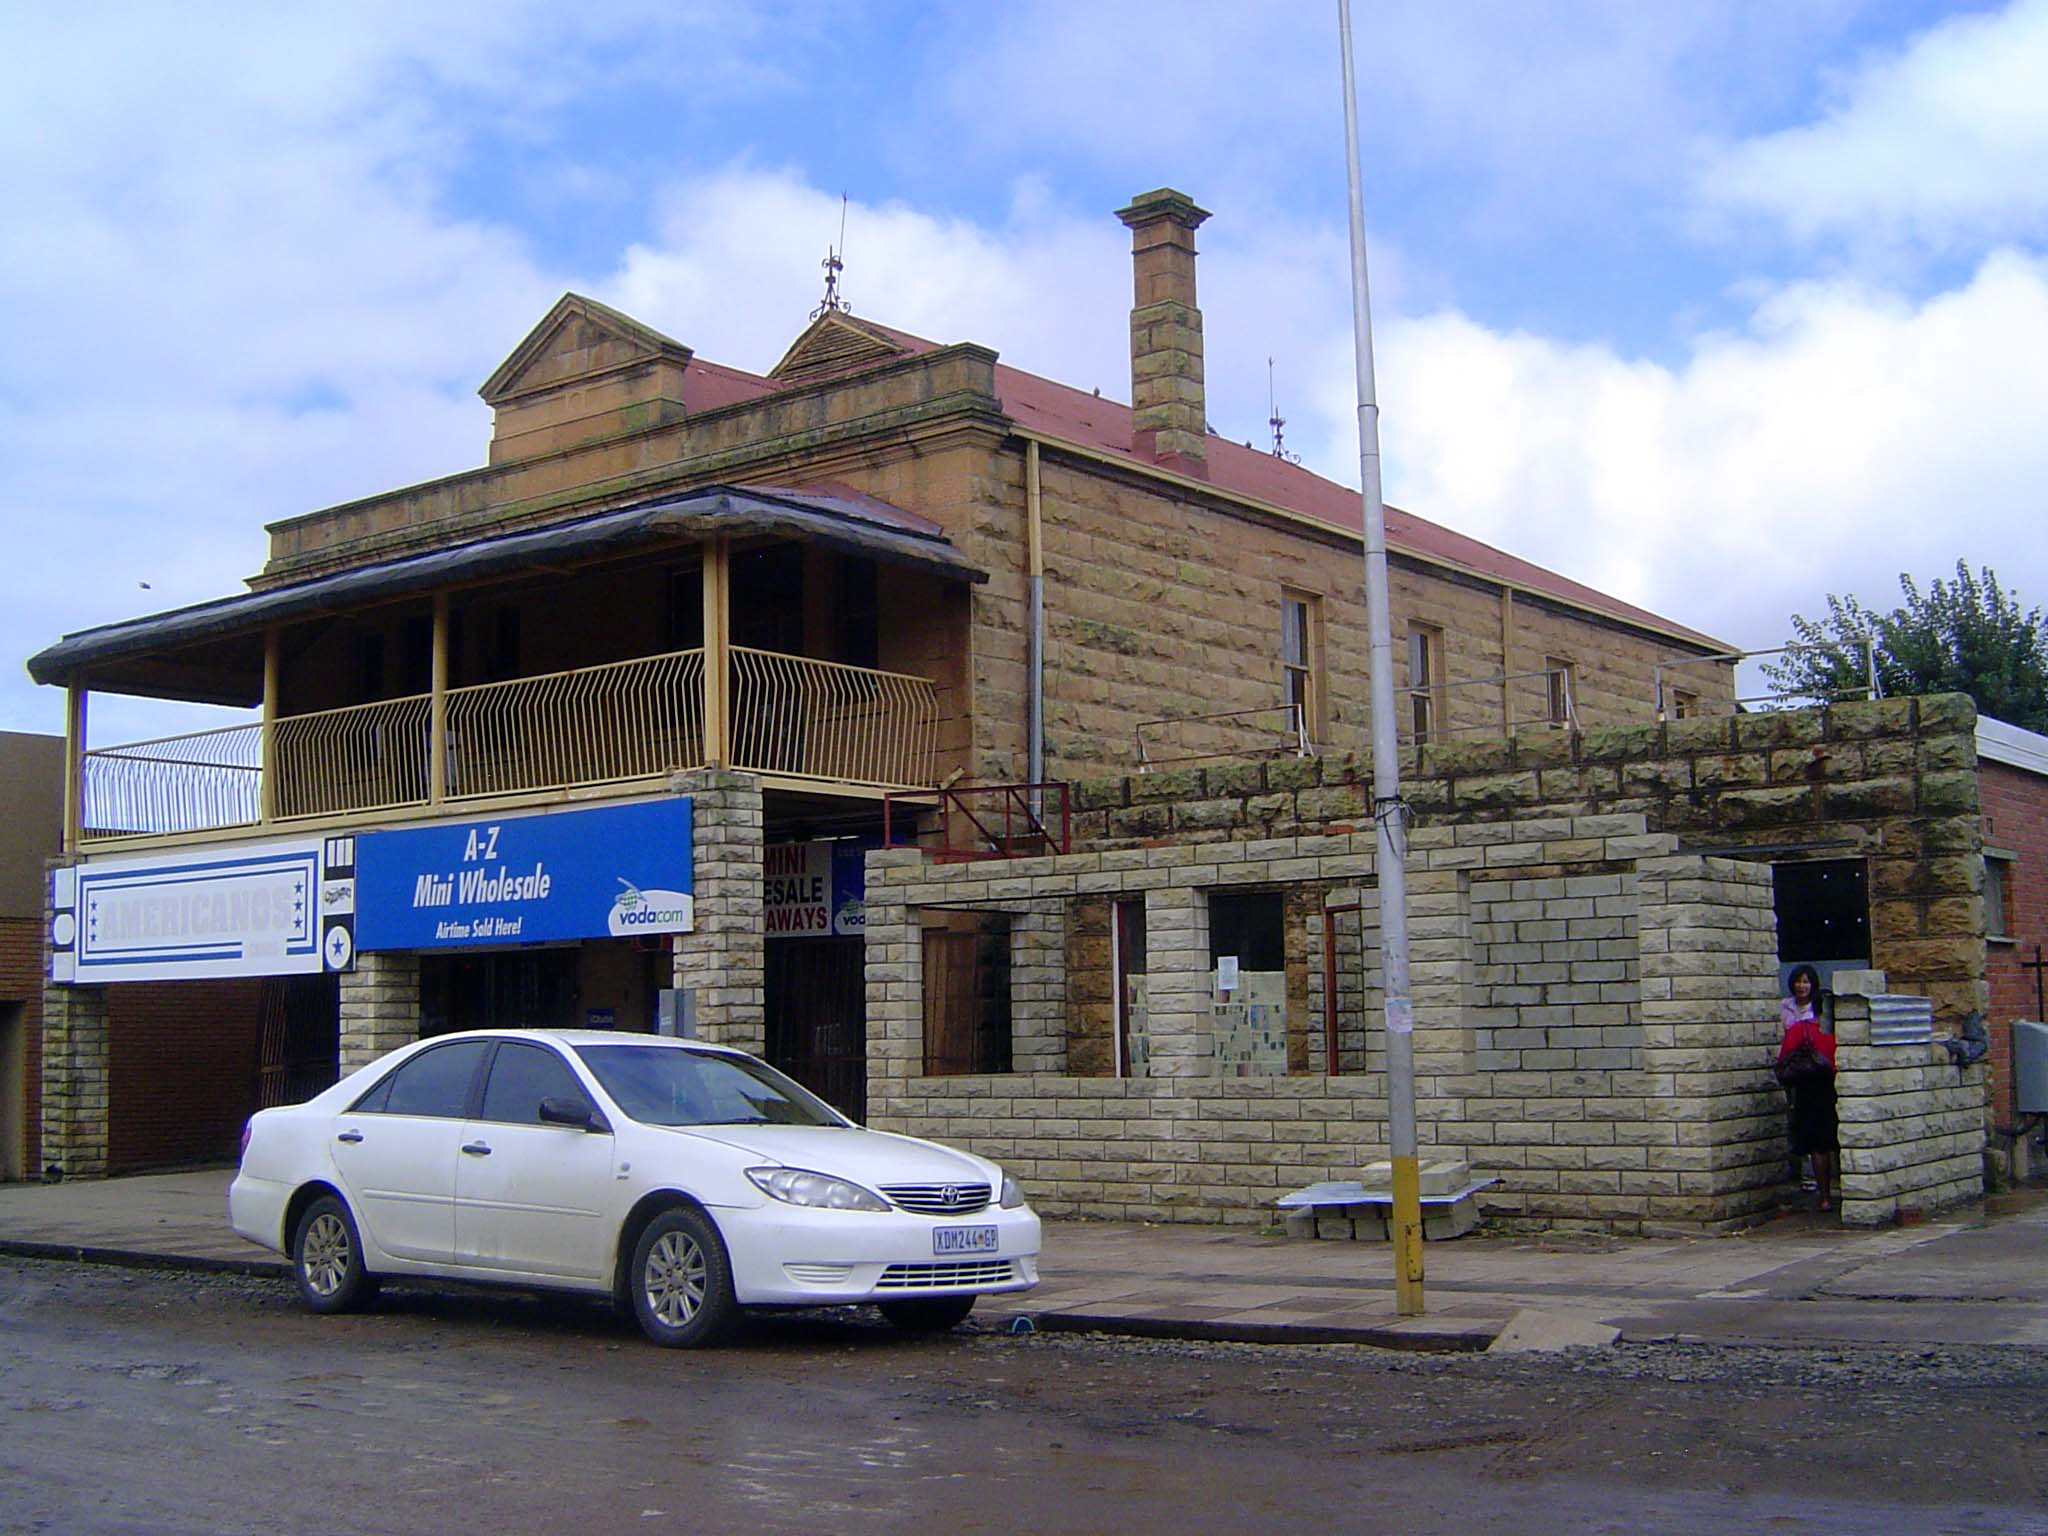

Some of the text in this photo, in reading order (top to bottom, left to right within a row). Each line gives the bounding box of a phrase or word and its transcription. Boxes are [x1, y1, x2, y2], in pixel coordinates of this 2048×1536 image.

[465, 826, 500, 861] A-Z
[413, 862, 550, 908] Mini Wholesale
[103, 887, 289, 938] AMERICANOS
[619, 906, 684, 925] vodacom
[435, 917, 522, 939] Airtime Sold Here!
[938, 1229, 996, 1249] XDM244 GP
